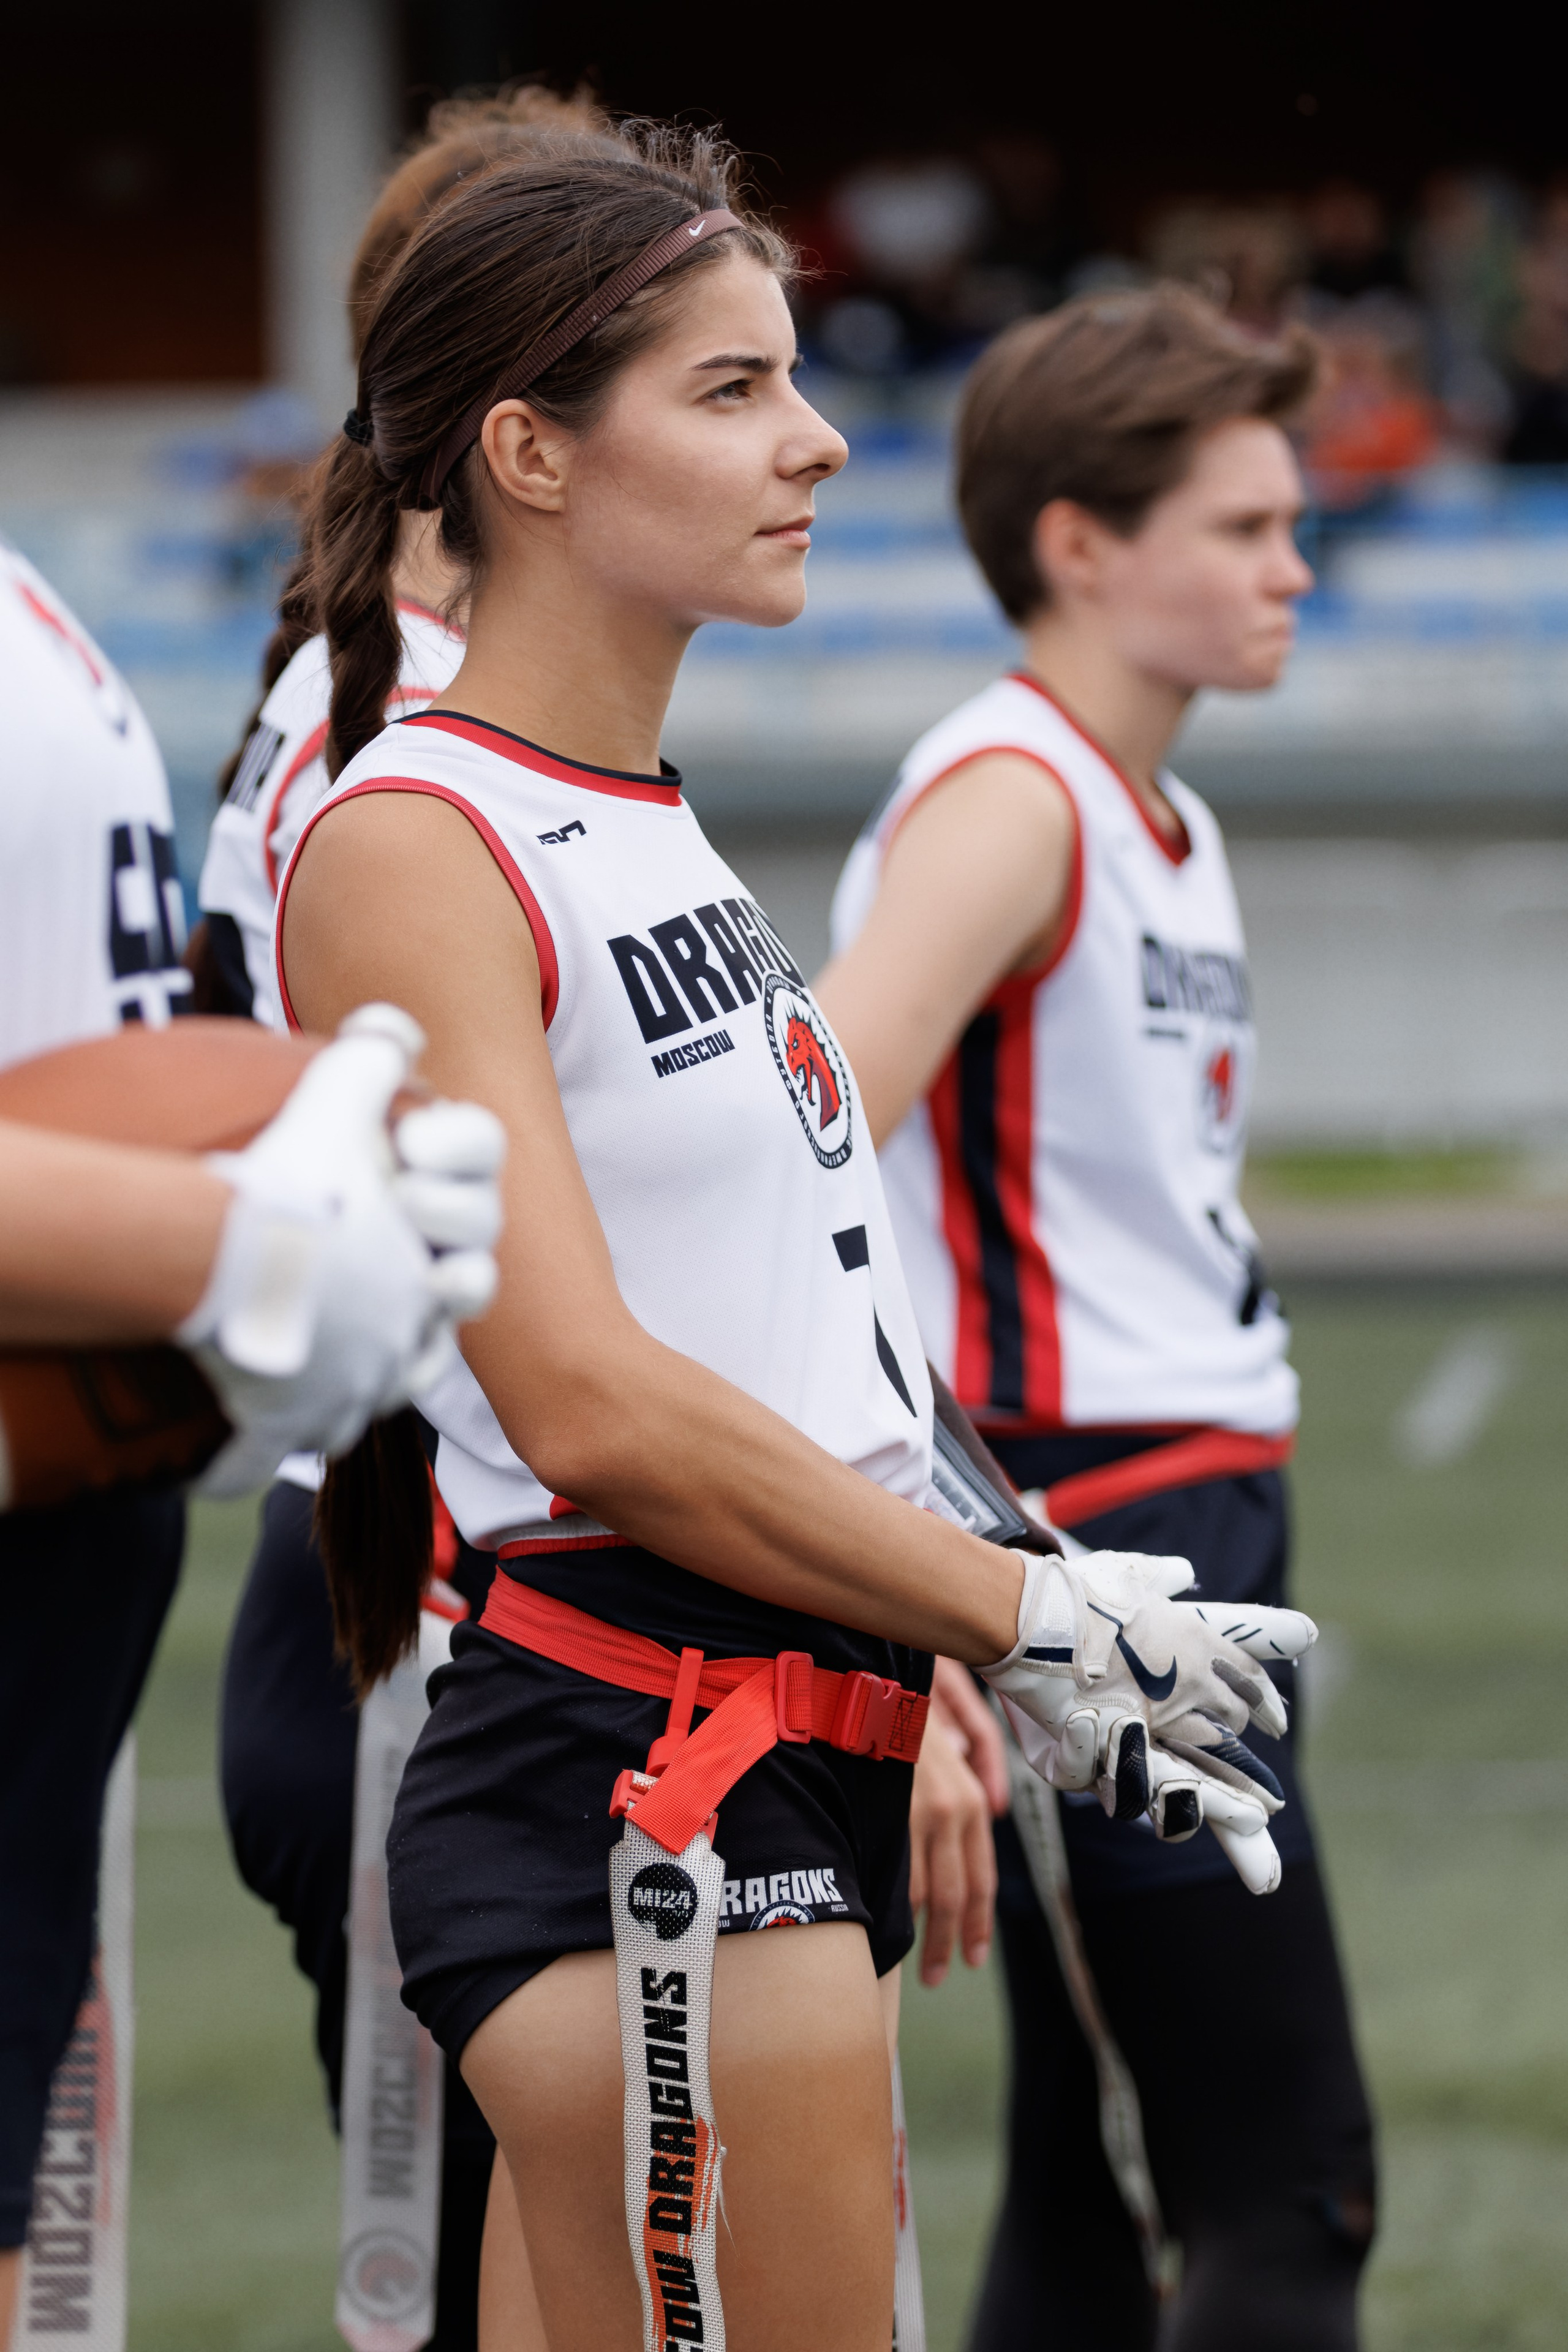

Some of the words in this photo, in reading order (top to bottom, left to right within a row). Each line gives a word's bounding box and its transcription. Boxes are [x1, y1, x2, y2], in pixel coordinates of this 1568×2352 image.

[606, 897, 808, 1045] DRAGO
[650, 1029, 736, 1079] MOSCOW
[633, 1887, 693, 1910] MI24
[718, 1868, 844, 1917] RAGONS
[641, 1967, 696, 2236] DRAGONS
[652, 2249, 705, 2352] OW
